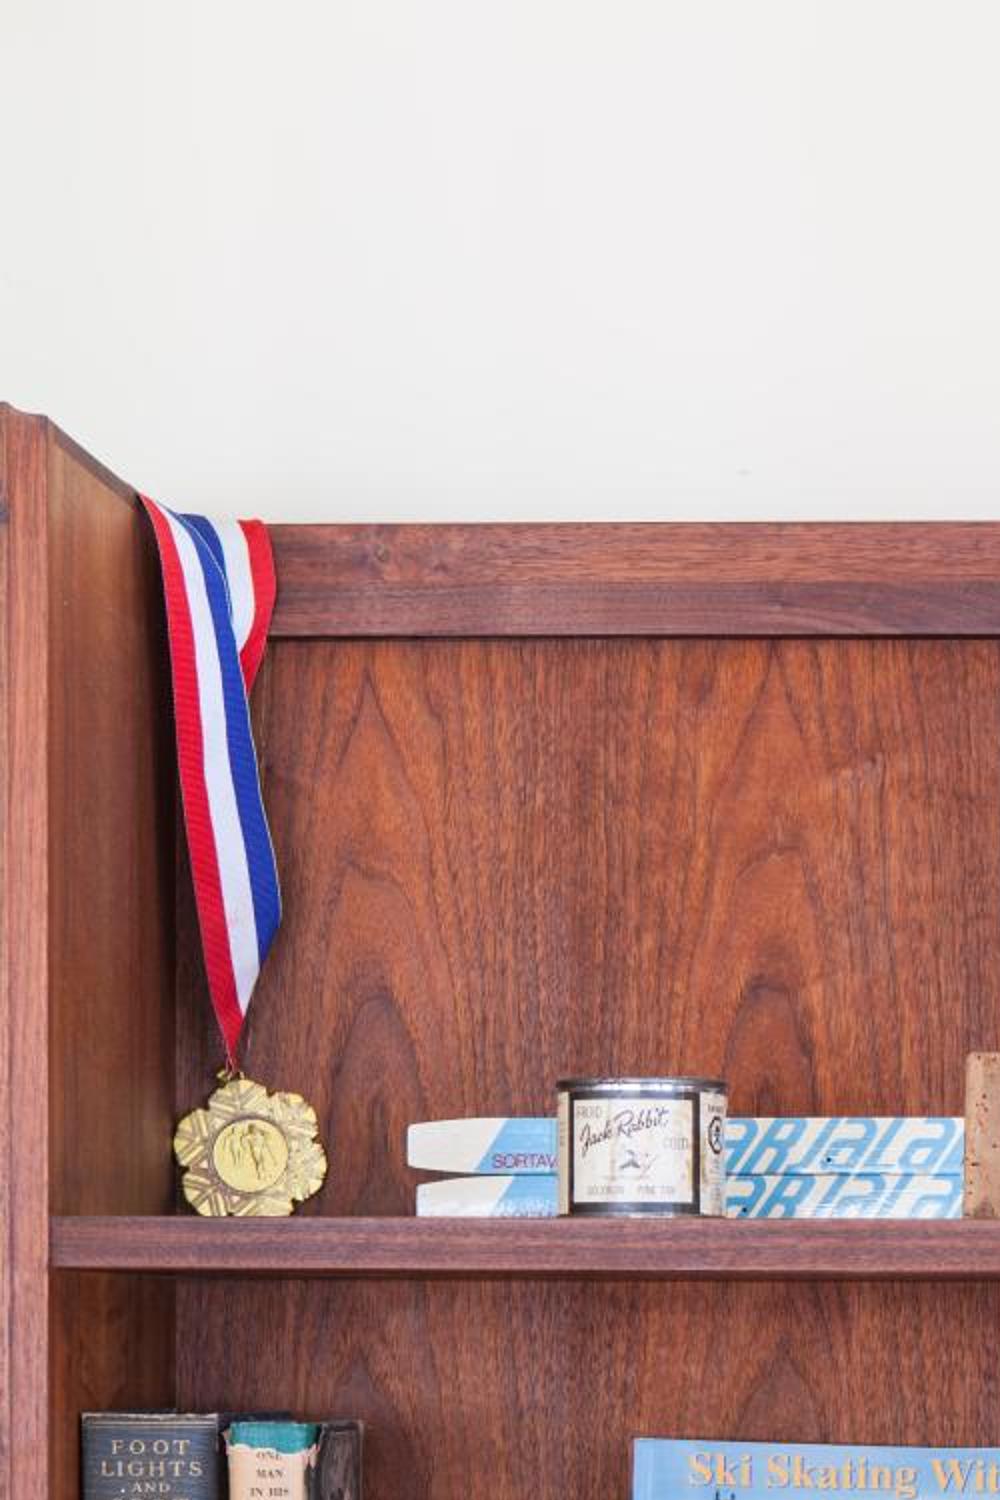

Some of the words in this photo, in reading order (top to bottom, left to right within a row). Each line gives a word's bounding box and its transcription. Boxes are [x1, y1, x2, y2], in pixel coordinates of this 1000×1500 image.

[579, 1122, 612, 1158] Jack
[111, 1439, 190, 1455] FOOT
[101, 1461, 203, 1477] LIGHTS
[256, 1469, 285, 1479] MAN
[688, 1453, 754, 1489] Ski
[766, 1454, 922, 1500] Skating
[131, 1482, 170, 1494] AND
[249, 1487, 263, 1497] IN
